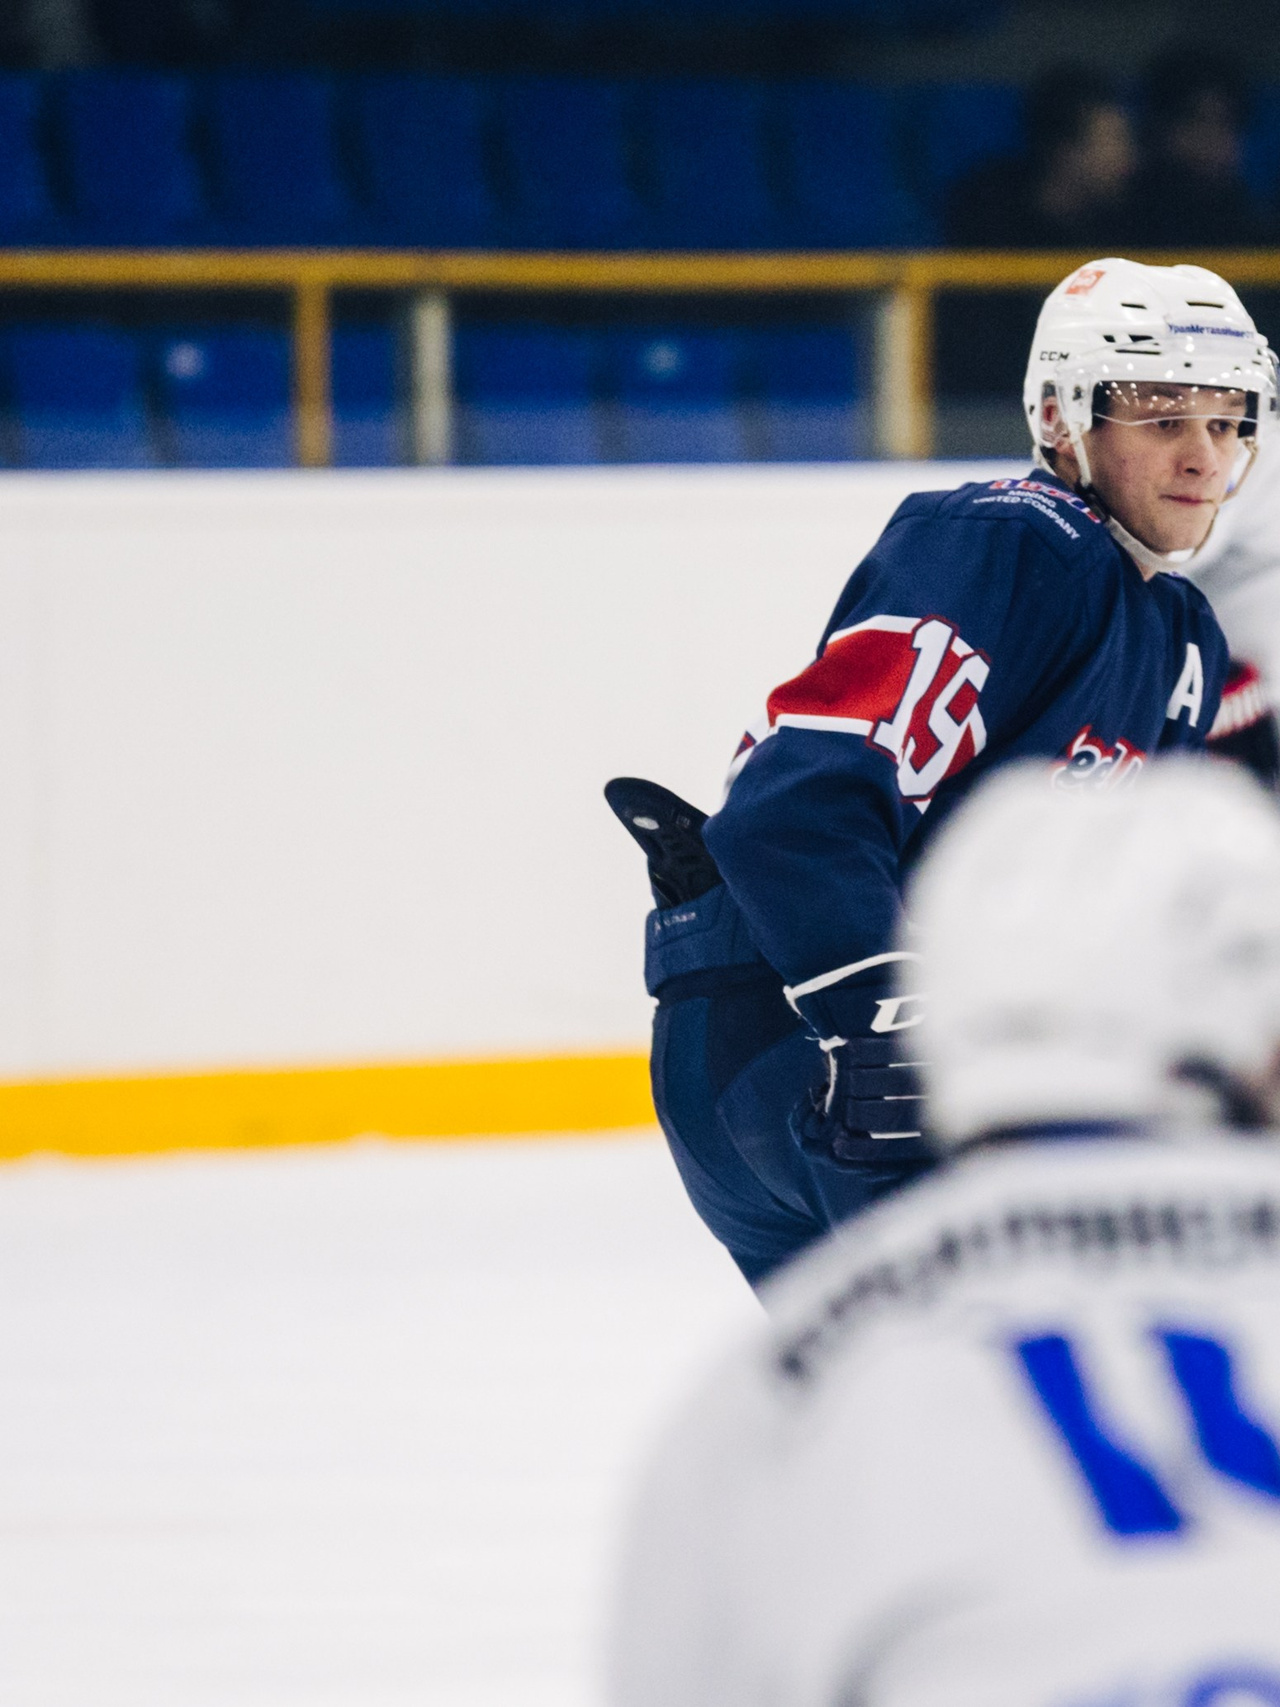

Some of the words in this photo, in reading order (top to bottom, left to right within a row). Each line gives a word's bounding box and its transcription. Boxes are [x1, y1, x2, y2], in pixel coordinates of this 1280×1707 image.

[1040, 351, 1070, 361] CCM
[1008, 489, 1058, 509] MINING
[1022, 497, 1081, 540] COMPANY
[1166, 641, 1203, 728] A
